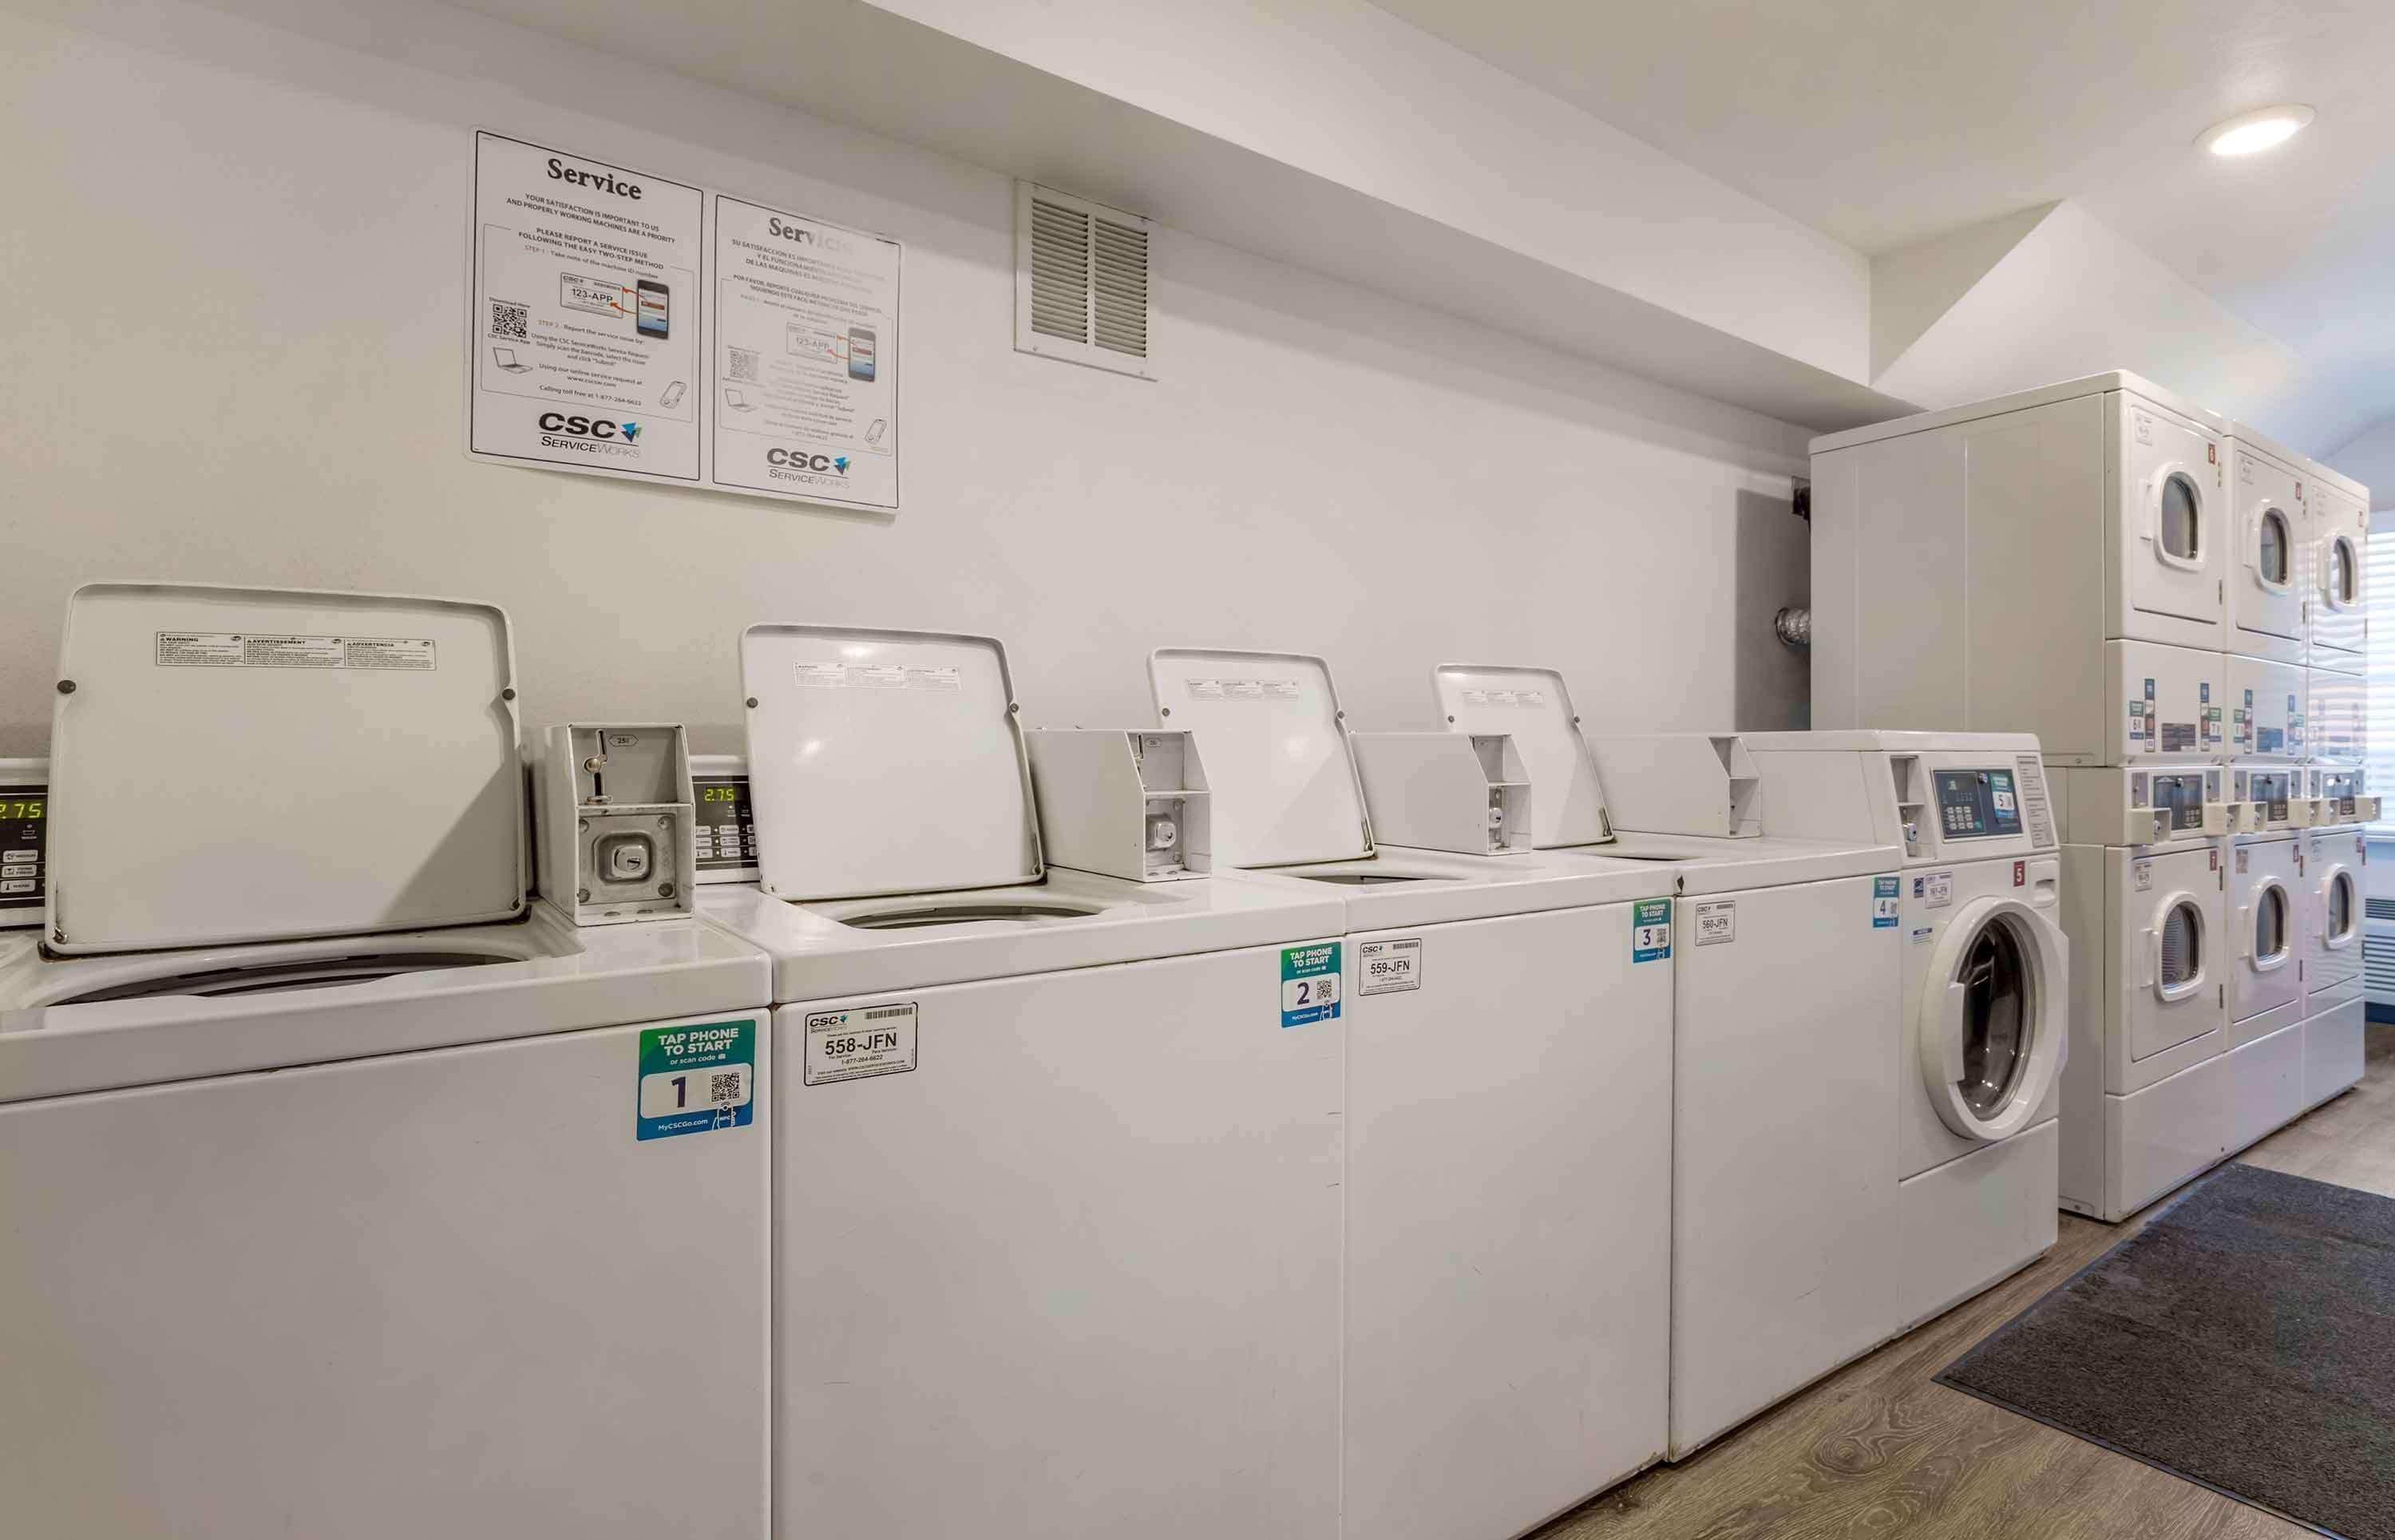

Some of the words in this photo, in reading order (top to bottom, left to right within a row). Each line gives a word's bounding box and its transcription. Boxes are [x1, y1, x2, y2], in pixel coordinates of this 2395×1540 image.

[548, 159, 642, 200] Service
[525, 193, 544, 204] YOUR
[546, 199, 593, 216] SATISFACTION
[602, 212, 639, 228] IMPORTANT
[506, 197, 522, 207] AND
[524, 202, 558, 216] PROPERLY
[560, 211, 592, 224] WORKING
[593, 219, 627, 232] MACHINES
[647, 232, 675, 244] PRIORITY
[536, 228, 562, 239] PLEASE
[564, 234, 592, 246] REPORT
[600, 242, 627, 254] SERVICE
[629, 249, 647, 259] ISSUE
[769, 217, 853, 254] Servic
[519, 232, 563, 247] FOLLOWING
[579, 245, 596, 255] EASY
[635, 259, 663, 270] METHOD
[572, 287, 613, 303] 123-APP
[539, 413, 616, 438] CSC
[766, 448, 830, 472] CSC
[704, 789, 734, 802] 2.75
[2017, 868, 2022, 882] 5
[1880, 901, 1886, 915] 4
[1702, 919, 1728, 928] 560-JFN
[1643, 928, 1651, 946] 3
[1290, 951, 1304, 960] TAP
[1306, 947, 1332, 958] PHONE
[1305, 956, 1329, 966] START
[1371, 960, 1410, 974] 559-JFN
[1297, 981, 1309, 1005] 2
[810, 1015, 838, 1027] CSC
[658, 1033, 687, 1046] TAP
[690, 1028, 738, 1043] PHONE
[825, 1032, 897, 1055] 558-JFN
[664, 1043, 684, 1056] TO
[687, 1039, 733, 1054] START
[670, 1076, 686, 1109] 1
[658, 1118, 708, 1131] MyCSCGo.com
